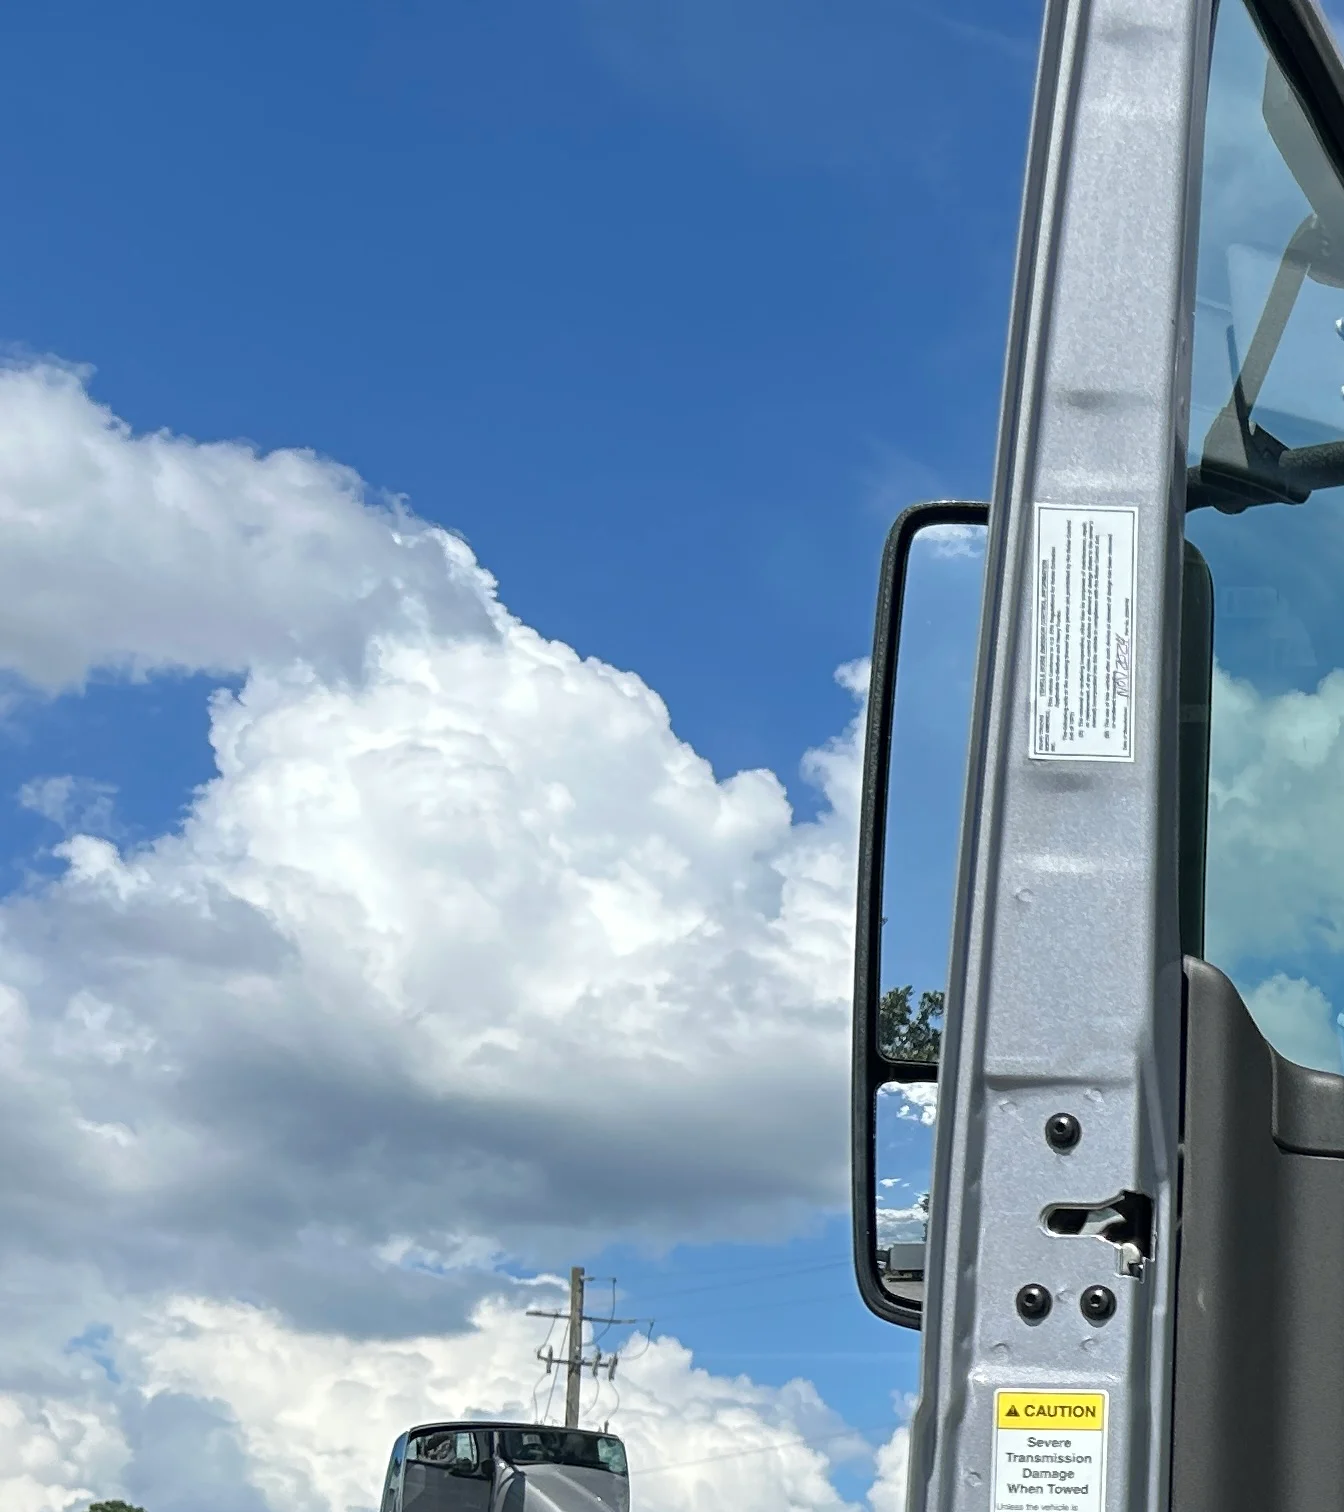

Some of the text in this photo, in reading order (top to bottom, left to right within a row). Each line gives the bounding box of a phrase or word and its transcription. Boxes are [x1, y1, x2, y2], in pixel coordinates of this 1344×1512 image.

[1024, 1405, 1096, 1418] CAUTION
[1027, 1437, 1071, 1448] Severe
[1006, 1452, 1092, 1463] Transmission
[1022, 1468, 1074, 1480] Damage
[1007, 1484, 1088, 1495] When Towed
